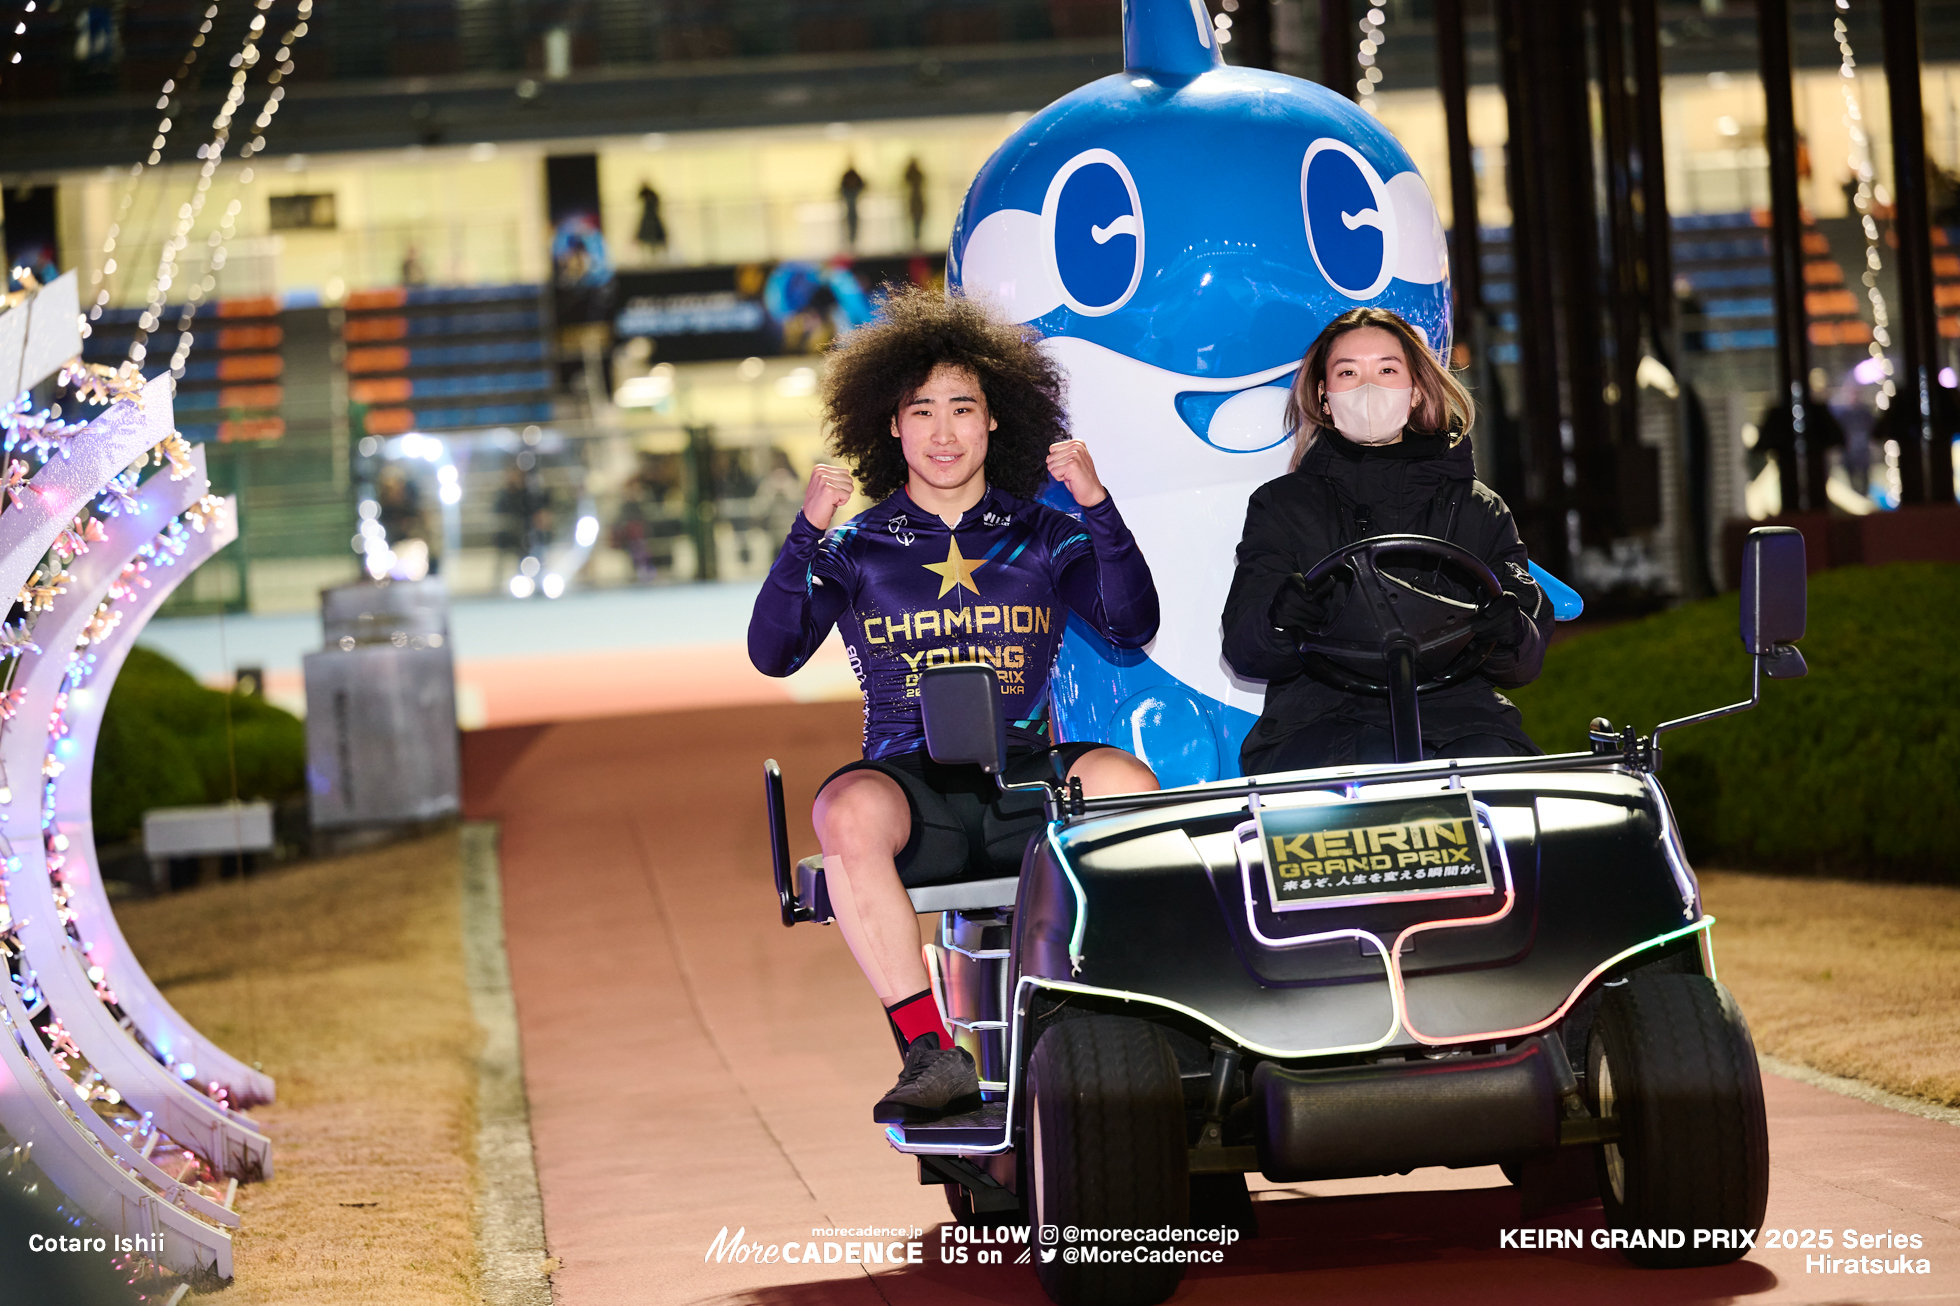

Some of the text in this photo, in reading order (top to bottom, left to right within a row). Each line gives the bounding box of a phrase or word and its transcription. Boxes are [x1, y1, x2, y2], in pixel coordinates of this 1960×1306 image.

[863, 605, 1051, 645] CHAMPION
[900, 646, 1025, 672] YOUNG
[996, 670, 1025, 684] RIX
[1272, 818, 1468, 862] KEIRIN
[1278, 846, 1472, 879] GRAND PRIX
[1282, 863, 1482, 892] 来るぞ、人生を変える瞬間が。
